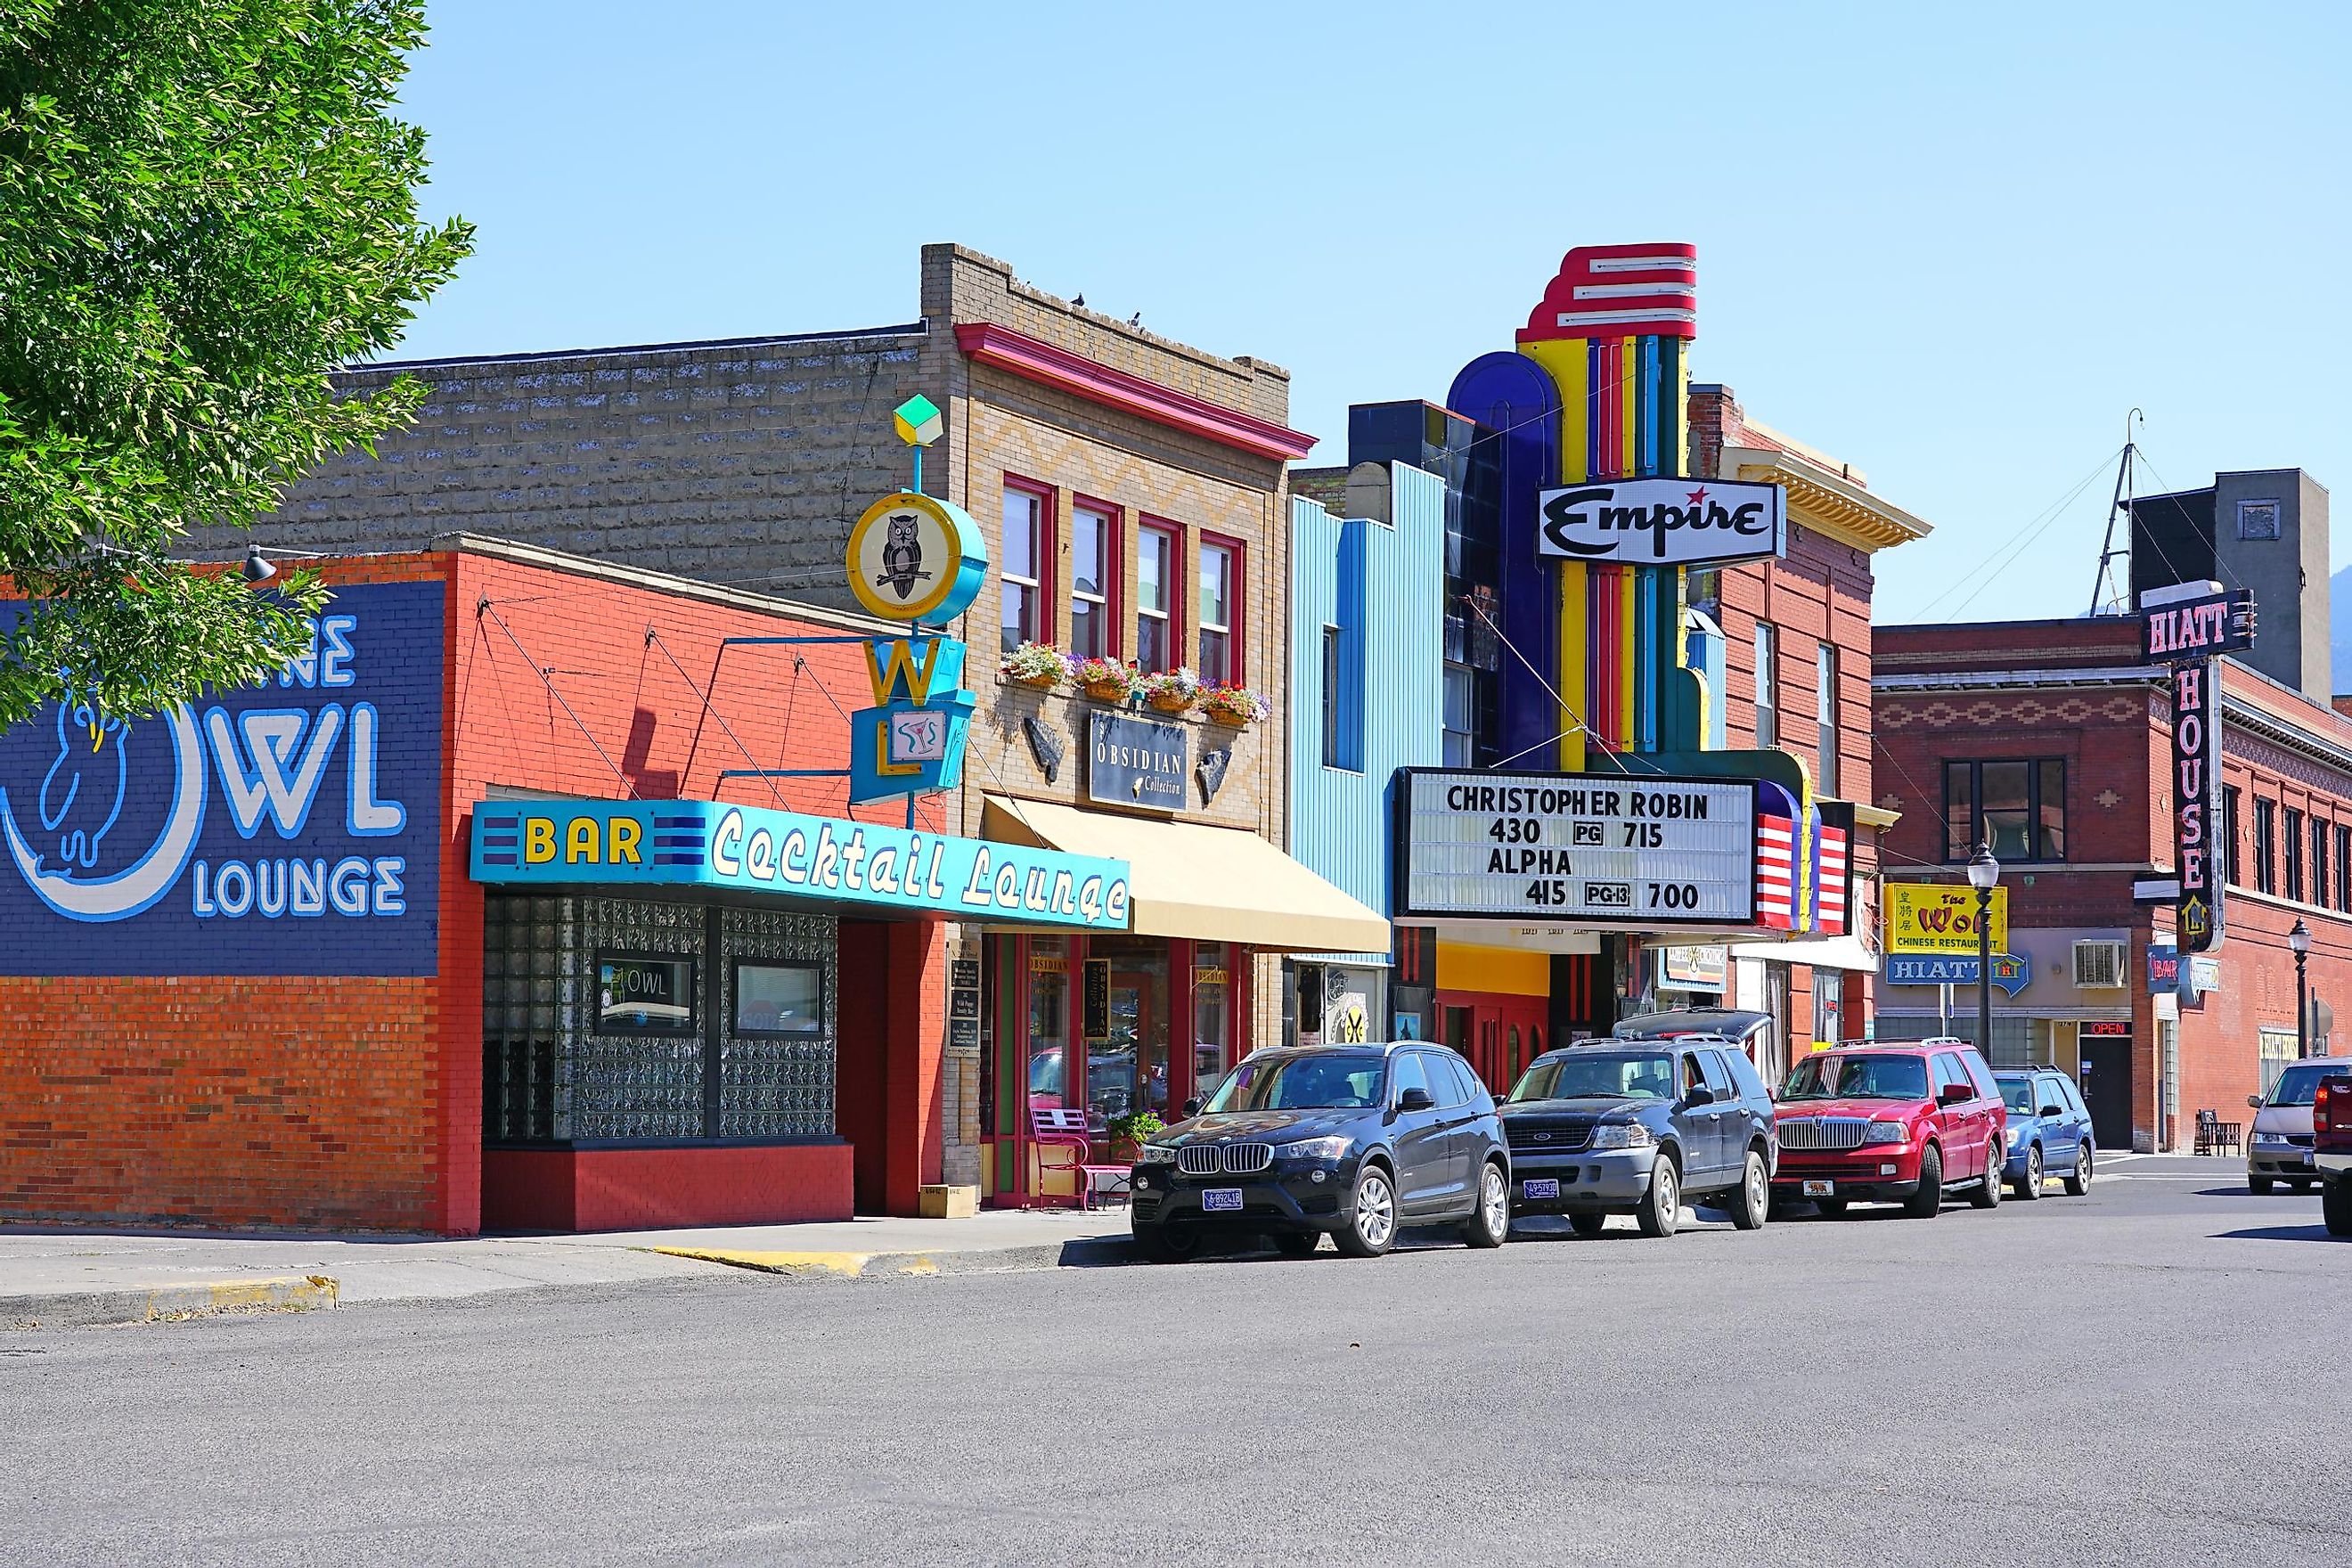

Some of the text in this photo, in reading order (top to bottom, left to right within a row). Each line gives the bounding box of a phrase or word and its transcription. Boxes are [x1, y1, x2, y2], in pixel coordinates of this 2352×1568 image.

[1543, 486, 1769, 557] Empire
[2149, 601, 2228, 654] HIATT
[1097, 742, 1181, 774] OBSIDIAN
[1144, 775, 1181, 795] Collection
[2178, 668, 2205, 890] HOUSE
[1447, 785, 1708, 819] CHRISTOPHER ROBIN
[524, 816, 643, 864] BAR
[1489, 818, 1663, 847] 430 PG 715
[712, 807, 1128, 923] Cocktail Lounge
[1487, 848, 1572, 876] ALPHA
[192, 855, 407, 919] LOUNGE
[1525, 880, 1566, 905] 415
[1648, 883, 1698, 909] 700
[1940, 893, 1967, 905] The
[1897, 937, 1935, 947] CHINESE
[1939, 938, 1998, 949] RESTAURT
[628, 969, 667, 995] OWL
[1196, 971, 1227, 982] BSIDIAN
[2154, 960, 2178, 981] BAR
[2092, 1023, 2125, 1034] OPEN
